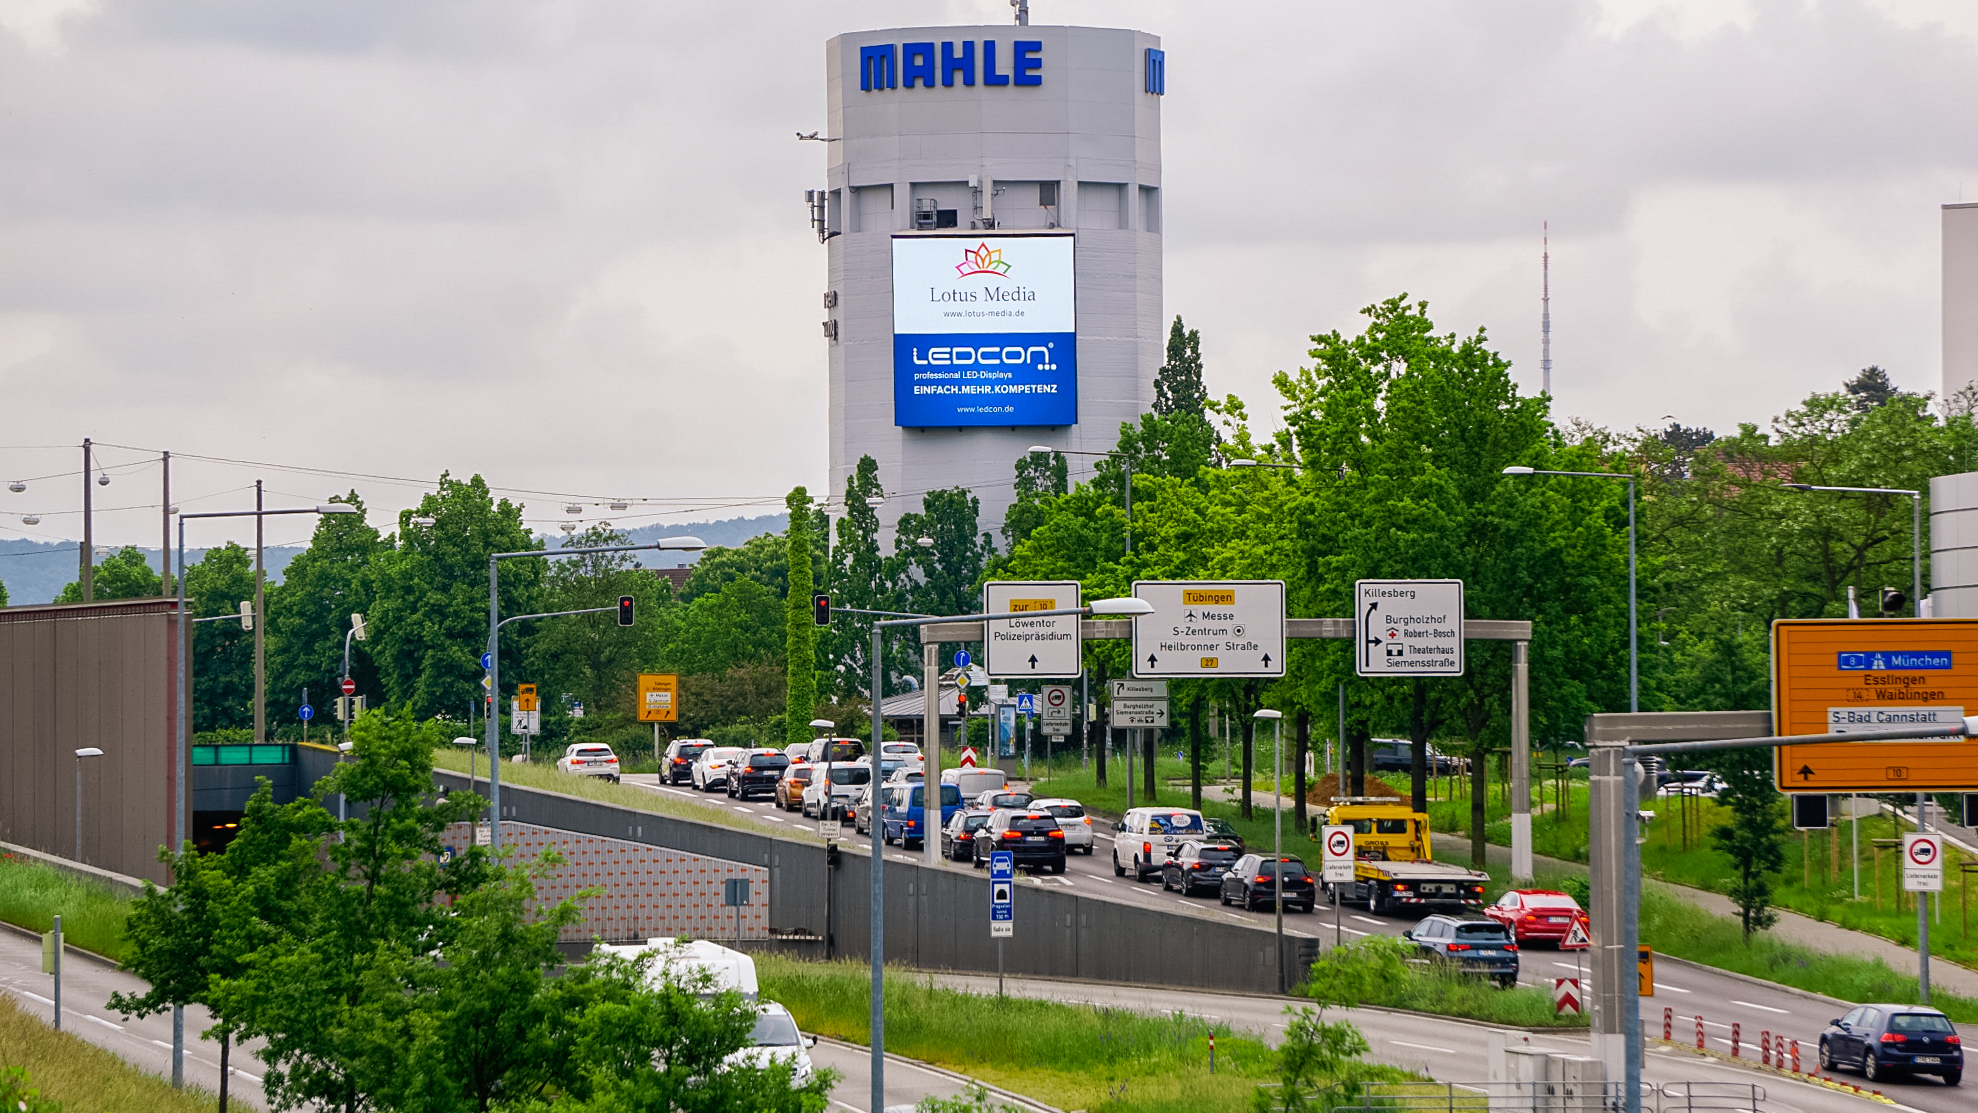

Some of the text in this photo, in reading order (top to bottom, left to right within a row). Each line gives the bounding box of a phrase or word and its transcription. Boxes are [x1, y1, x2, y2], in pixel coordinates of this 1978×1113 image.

[860, 40, 1042, 91] MAHLE
[930, 286, 1036, 302] Lotus Media
[943, 309, 1025, 318] www.lotus-media.de
[914, 371, 1013, 380] professional LED-Displays
[914, 384, 1058, 395] EINFACH.MEHR.KOMPETENZ
[957, 405, 1015, 413] www.ledcon.de
[1186, 592, 1232, 604] Tübingen
[1364, 588, 1416, 600] Killesberg
[1013, 603, 1048, 612] zur 10
[1202, 611, 1235, 620] Messe
[1385, 614, 1447, 626] Burgholzhof
[1008, 618, 1057, 628] Löwentor
[1172, 626, 1228, 636] S-Zentrum
[1403, 628, 1455, 638] Robert-Bosch
[994, 631, 1072, 642] Polizeipräsidium
[1160, 641, 1259, 651] Heilbronner Straße
[1408, 645, 1455, 654] Theaterhaus
[1204, 659, 1214, 667] 27
[1386, 658, 1456, 668] Siemensstraße
[1891, 654, 1948, 667] München
[1864, 674, 1926, 688] Esslingen
[1853, 688, 1945, 703] 14 Waiblingen
[1832, 711, 1937, 723] S-Bad Cannstatt
[1892, 768, 1902, 778] 10
